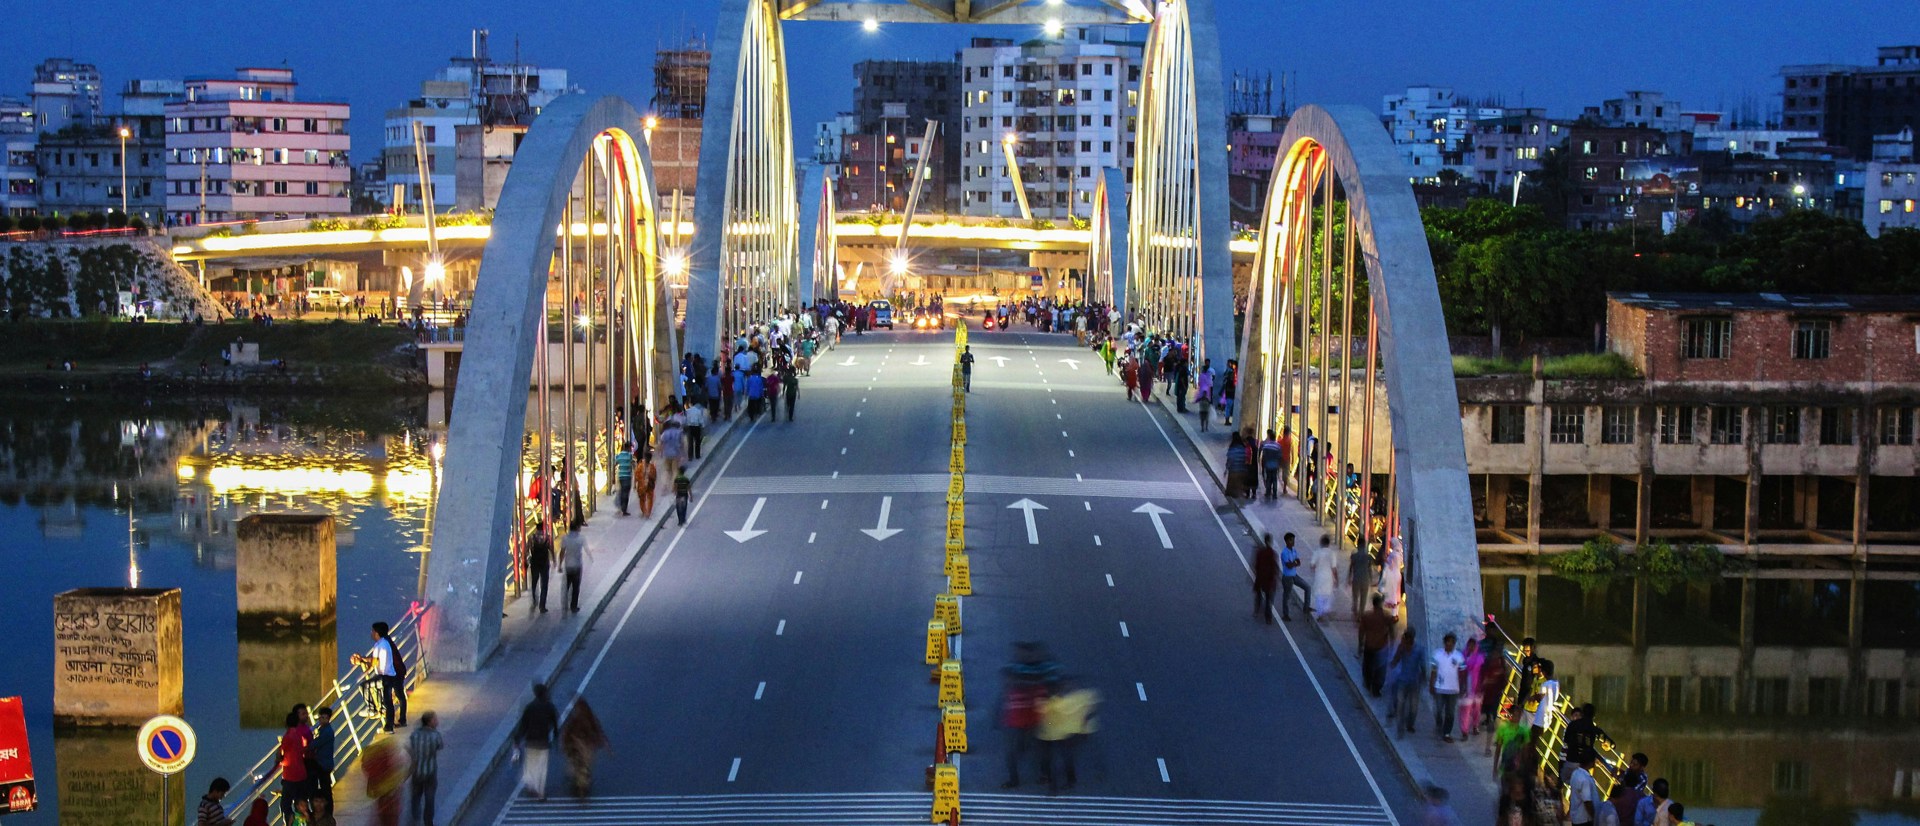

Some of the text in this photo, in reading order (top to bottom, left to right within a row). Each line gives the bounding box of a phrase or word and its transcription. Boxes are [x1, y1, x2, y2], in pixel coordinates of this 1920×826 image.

[104, 612, 155, 634] ঘেরাও
[109, 662, 144, 678] ঘেরাও
[0, 747, 18, 762] ষেধ
